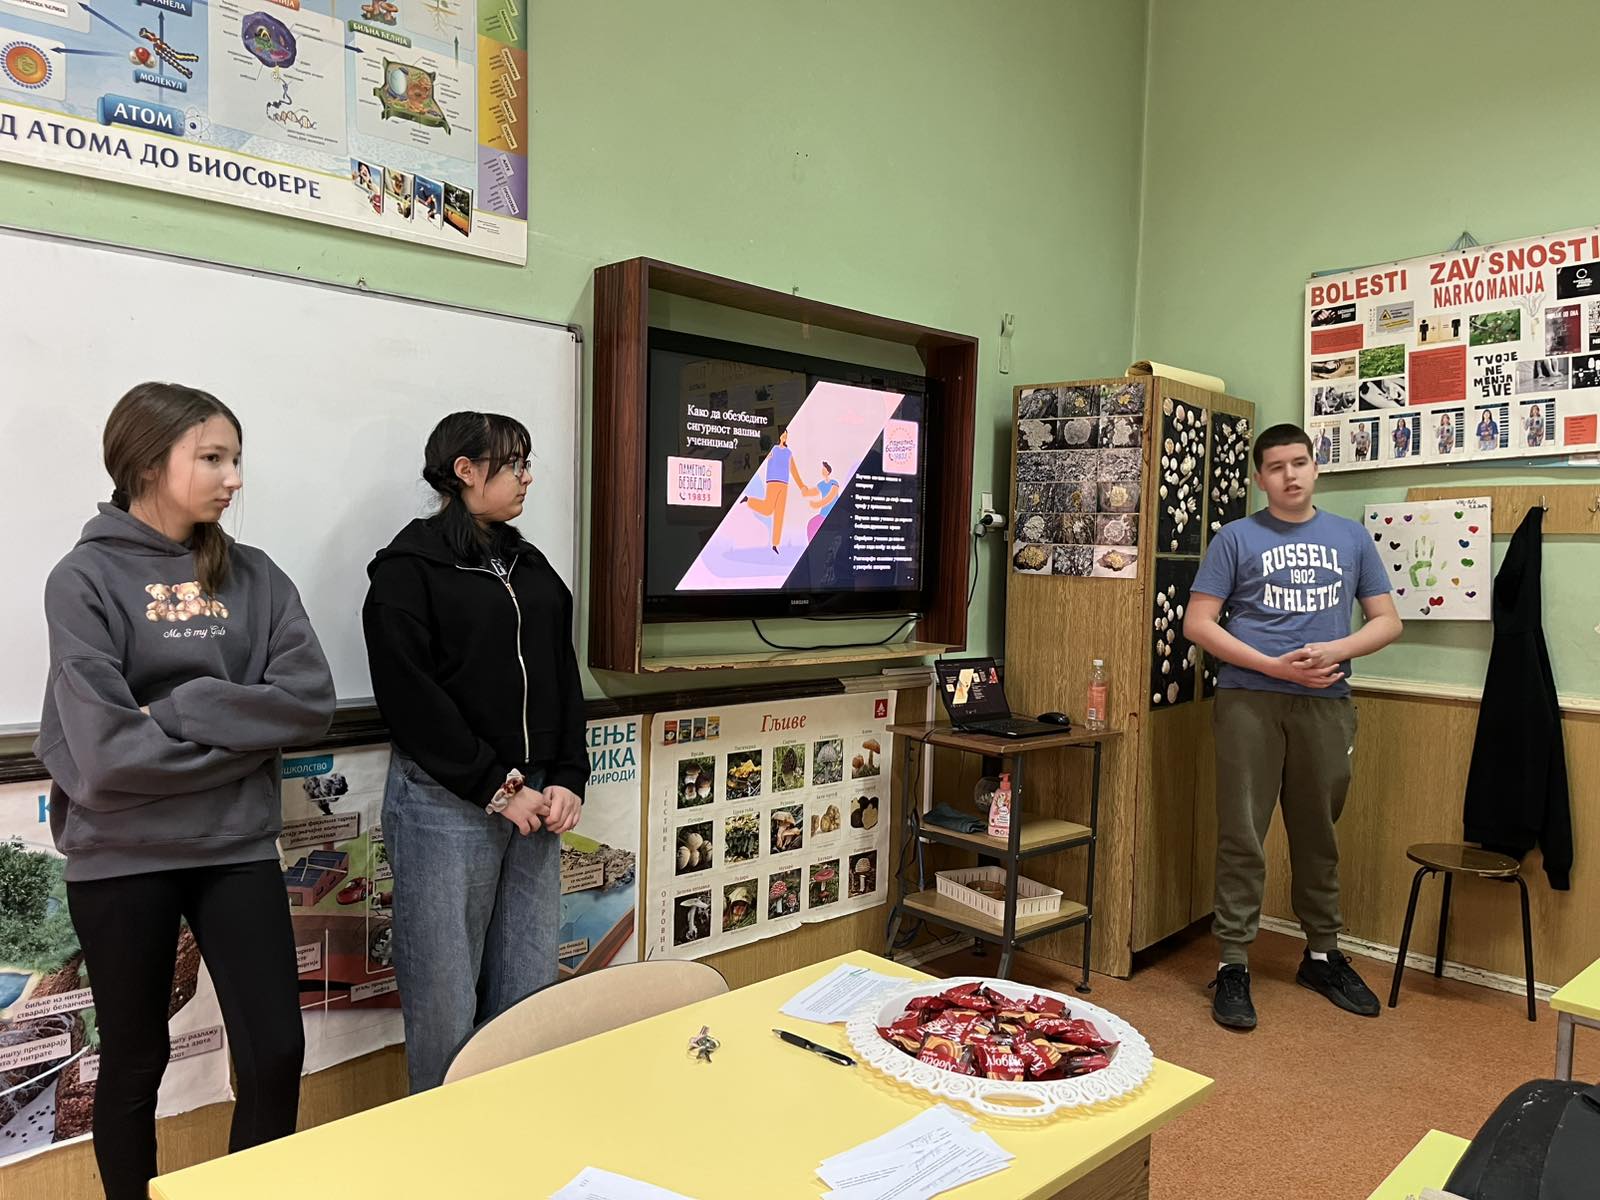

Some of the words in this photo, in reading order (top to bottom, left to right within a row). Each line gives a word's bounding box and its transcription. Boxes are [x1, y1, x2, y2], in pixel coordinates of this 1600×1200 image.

[353, 22, 380, 37] БИЉНА
[139, 72, 183, 90] МОЛЕКУЛ
[114, 102, 173, 129] АТОМ
[27, 120, 132, 159] АТОМА
[140, 143, 179, 169] ДО
[188, 153, 321, 200] БИОСФЕРЕ
[1311, 269, 1407, 306] BOLESTI
[1434, 270, 1544, 308] NARKOMANIJA
[1474, 351, 1518, 366] TVOJE
[1485, 364, 1502, 376] NE
[1473, 374, 1513, 387] MENJA
[1482, 383, 1512, 398] SVE
[687, 404, 709, 417] Како
[710, 410, 721, 419] да
[722, 409, 768, 424] обезбедите
[687, 422, 731, 434] сигурност
[733, 427, 761, 438] вашим
[686, 436, 738, 449] ученицима?
[1261, 542, 1343, 577] RUSSELL
[1290, 568, 1316, 584] 1902
[1262, 580, 1342, 612] ATHLETIC
[193, 629, 208, 638] my
[760, 714, 807, 733] Гљиве
[591, 747, 636, 771] ИКА
[17, 1007, 51, 1020] стварају
[53, 999, 94, 1011] беланчев
[25, 999, 51, 1010] биљке
[65, 991, 91, 1004] нитрат
[0, 1049, 22, 1060] ишту
[24, 1038, 68, 1055] претварају
[21, 1049, 53, 1062] нитрате
